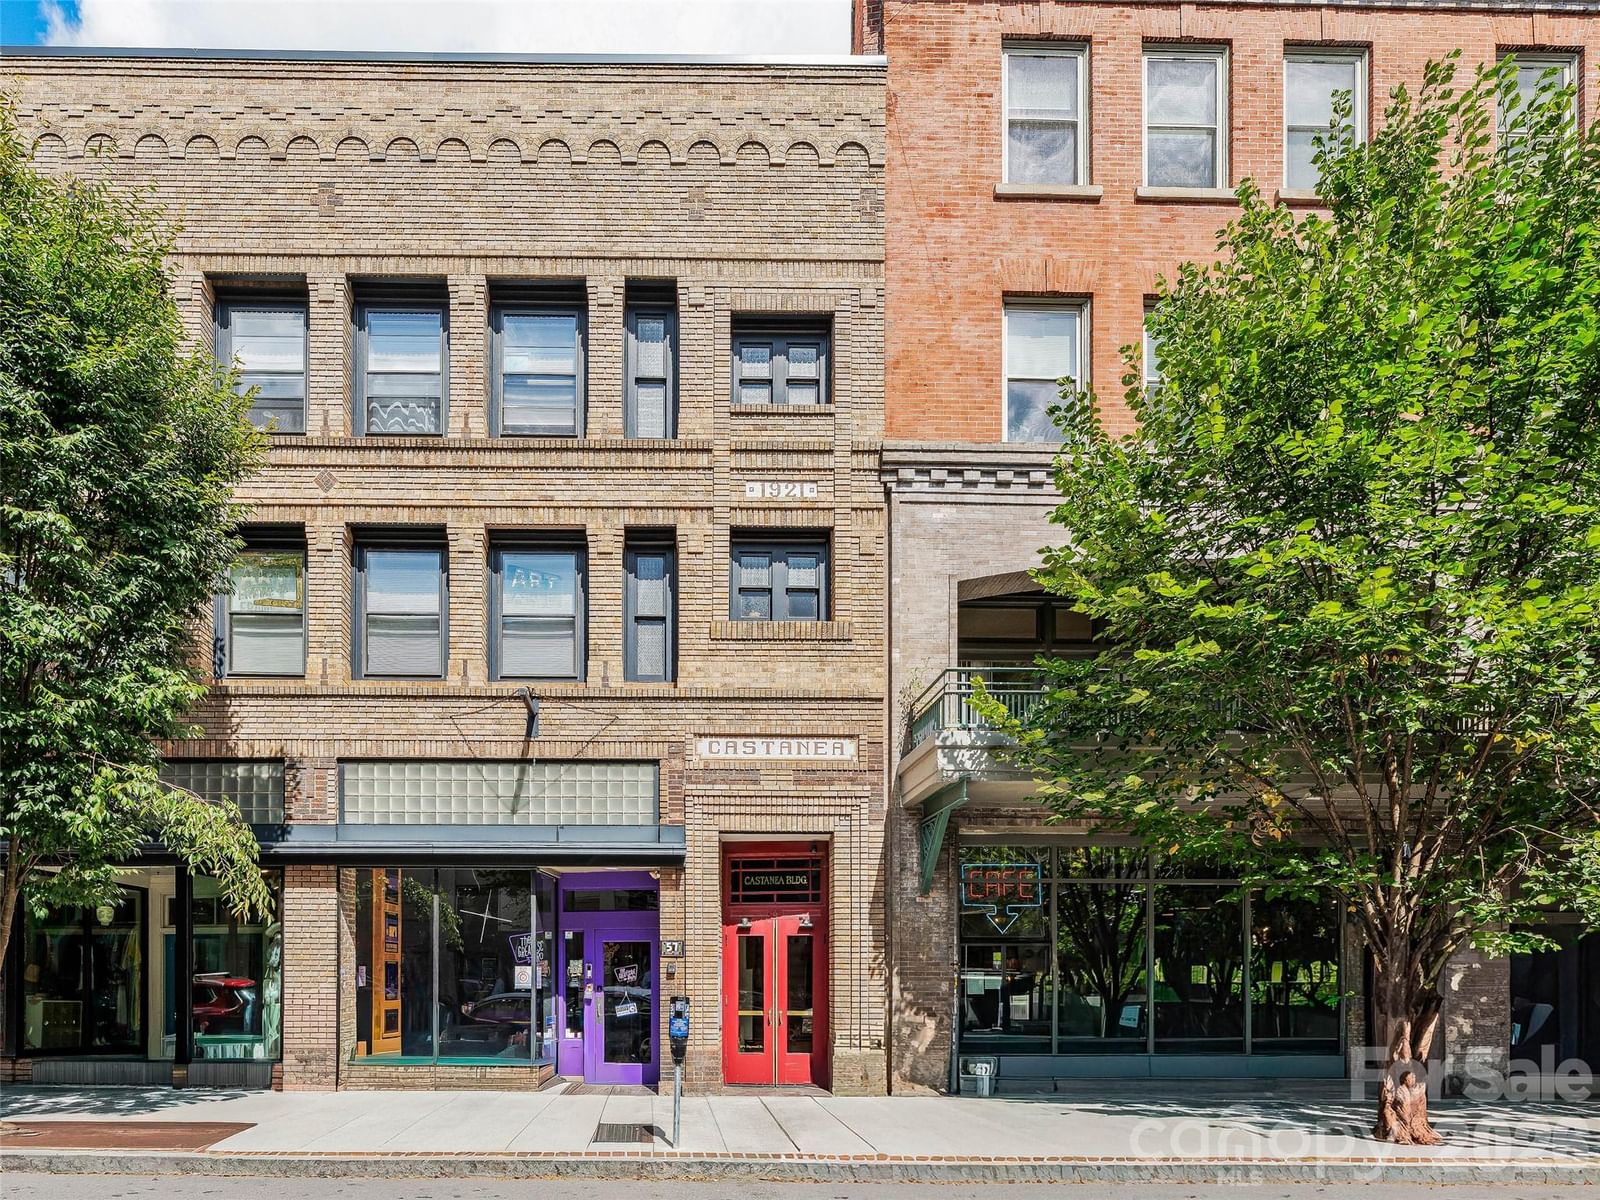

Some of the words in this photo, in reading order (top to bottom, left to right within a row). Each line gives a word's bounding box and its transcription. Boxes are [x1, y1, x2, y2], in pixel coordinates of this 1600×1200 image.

[761, 482, 804, 498] 1921
[707, 740, 846, 756] CASTANEA
[744, 876, 784, 886] CASTANEA
[969, 870, 1034, 898] CAFE
[665, 942, 679, 952] 57
